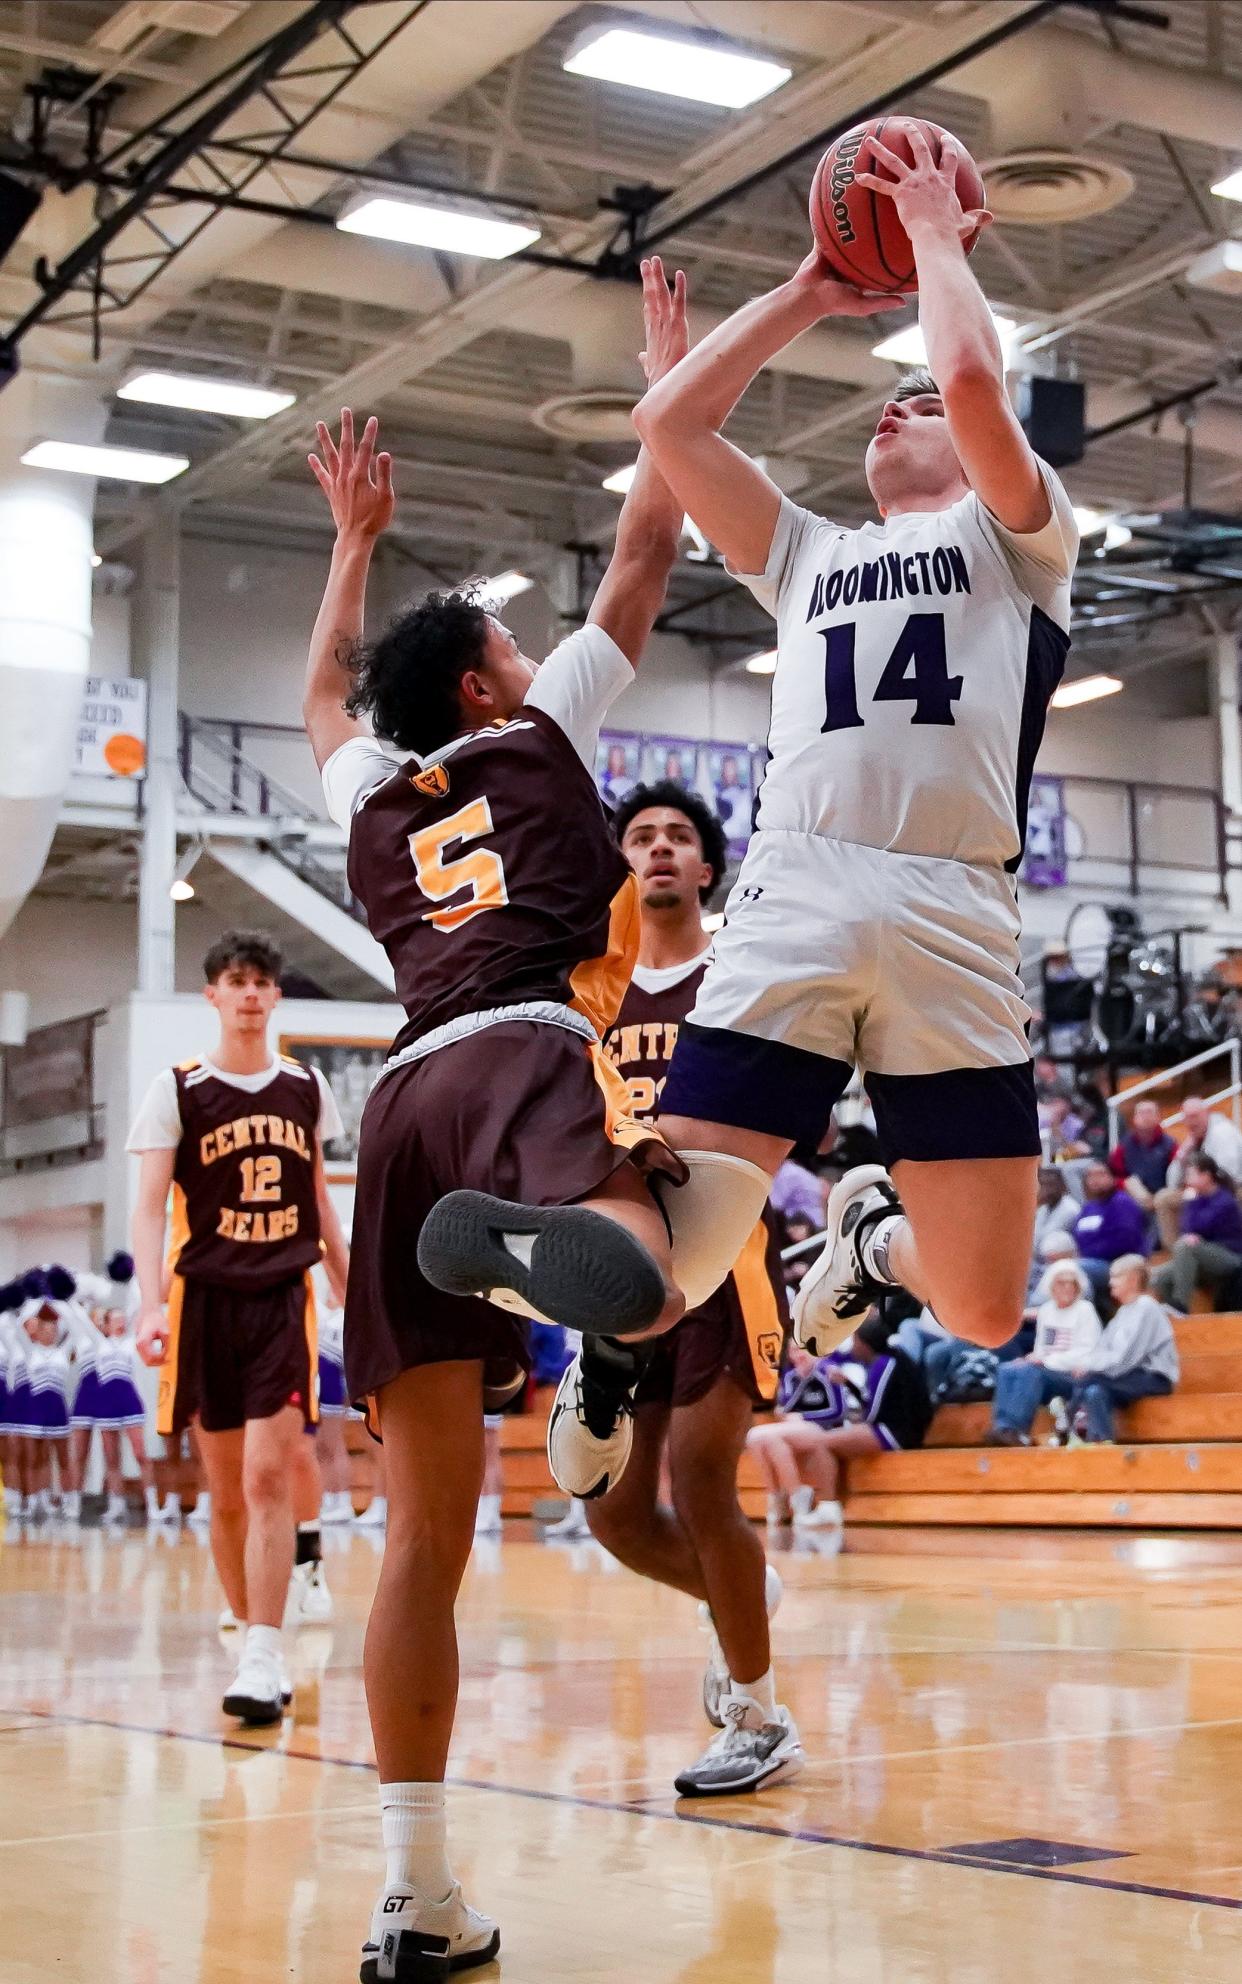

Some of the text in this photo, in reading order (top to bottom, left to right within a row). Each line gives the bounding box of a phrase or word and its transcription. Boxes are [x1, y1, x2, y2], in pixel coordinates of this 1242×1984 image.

[830, 129, 868, 245] Wilson
[816, 612, 964, 734] 14
[408, 795, 510, 934] 5
[200, 1114, 312, 1168] CENTRAL
[240, 1155, 282, 1203] 12
[216, 1204, 299, 1243] BEARS
[383, 1895, 415, 1914] GT
